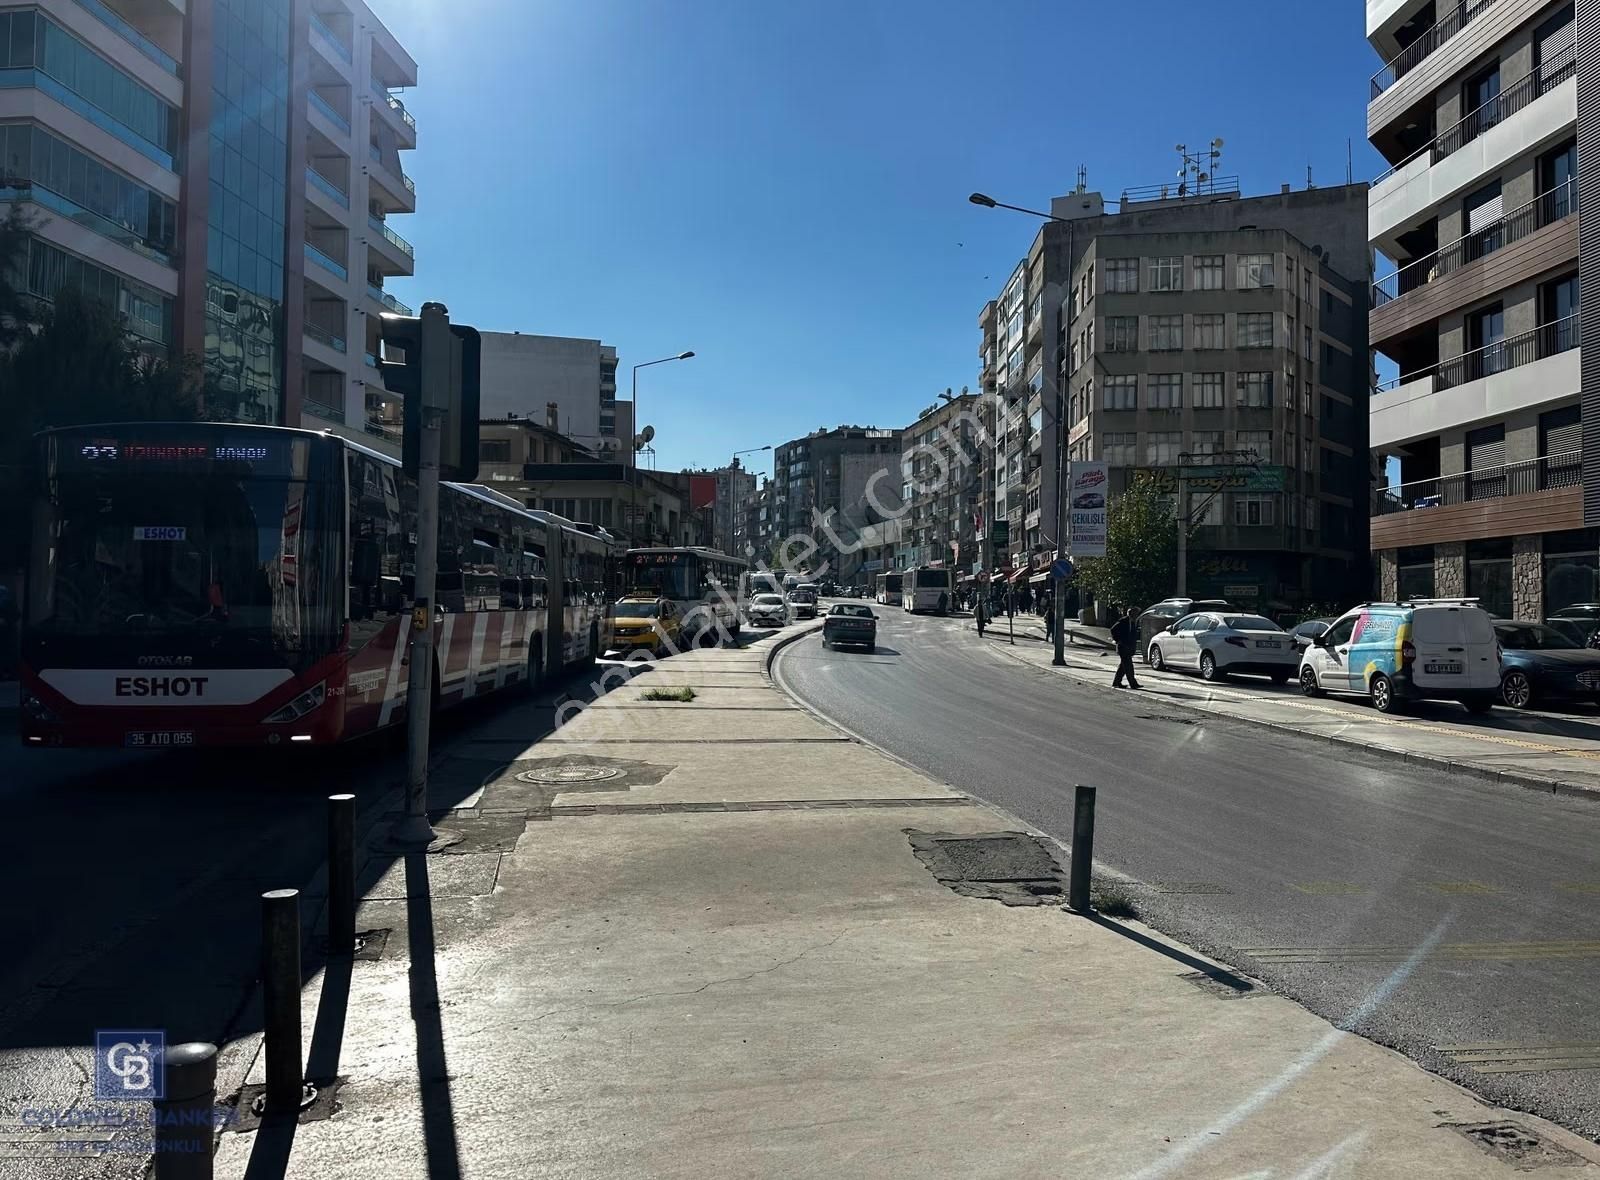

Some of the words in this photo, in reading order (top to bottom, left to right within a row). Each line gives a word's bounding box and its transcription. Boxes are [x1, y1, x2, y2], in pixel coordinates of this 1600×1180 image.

[144, 528, 185, 540] ESHOT
[115, 677, 209, 697] ESHOT
[132, 733, 144, 745] 35
